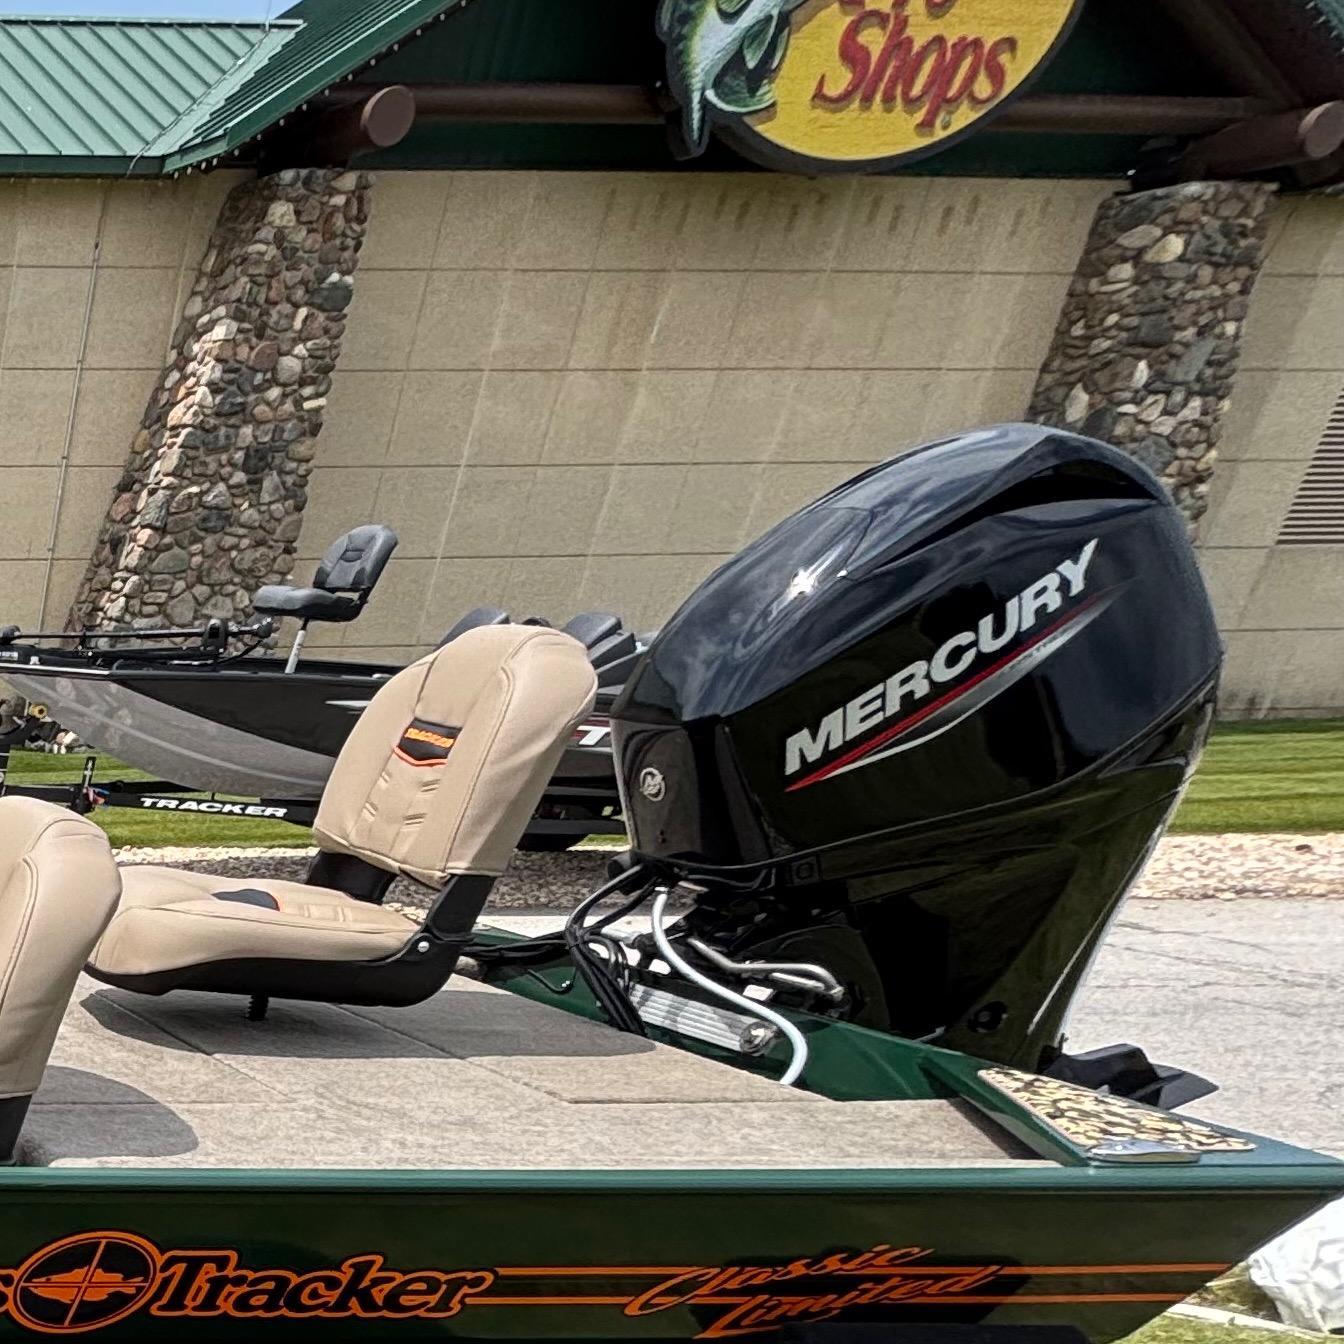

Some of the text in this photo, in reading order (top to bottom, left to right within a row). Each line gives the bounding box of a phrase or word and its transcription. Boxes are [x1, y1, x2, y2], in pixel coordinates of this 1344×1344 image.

[812, 9, 1018, 132] Shops
[784, 538, 1098, 775] MERCURY
[140, 797, 288, 818] TRACKER
[153, 1251, 493, 1316] Tracker
[624, 1244, 935, 1317] Classic
[692, 1265, 1004, 1339] Limited
